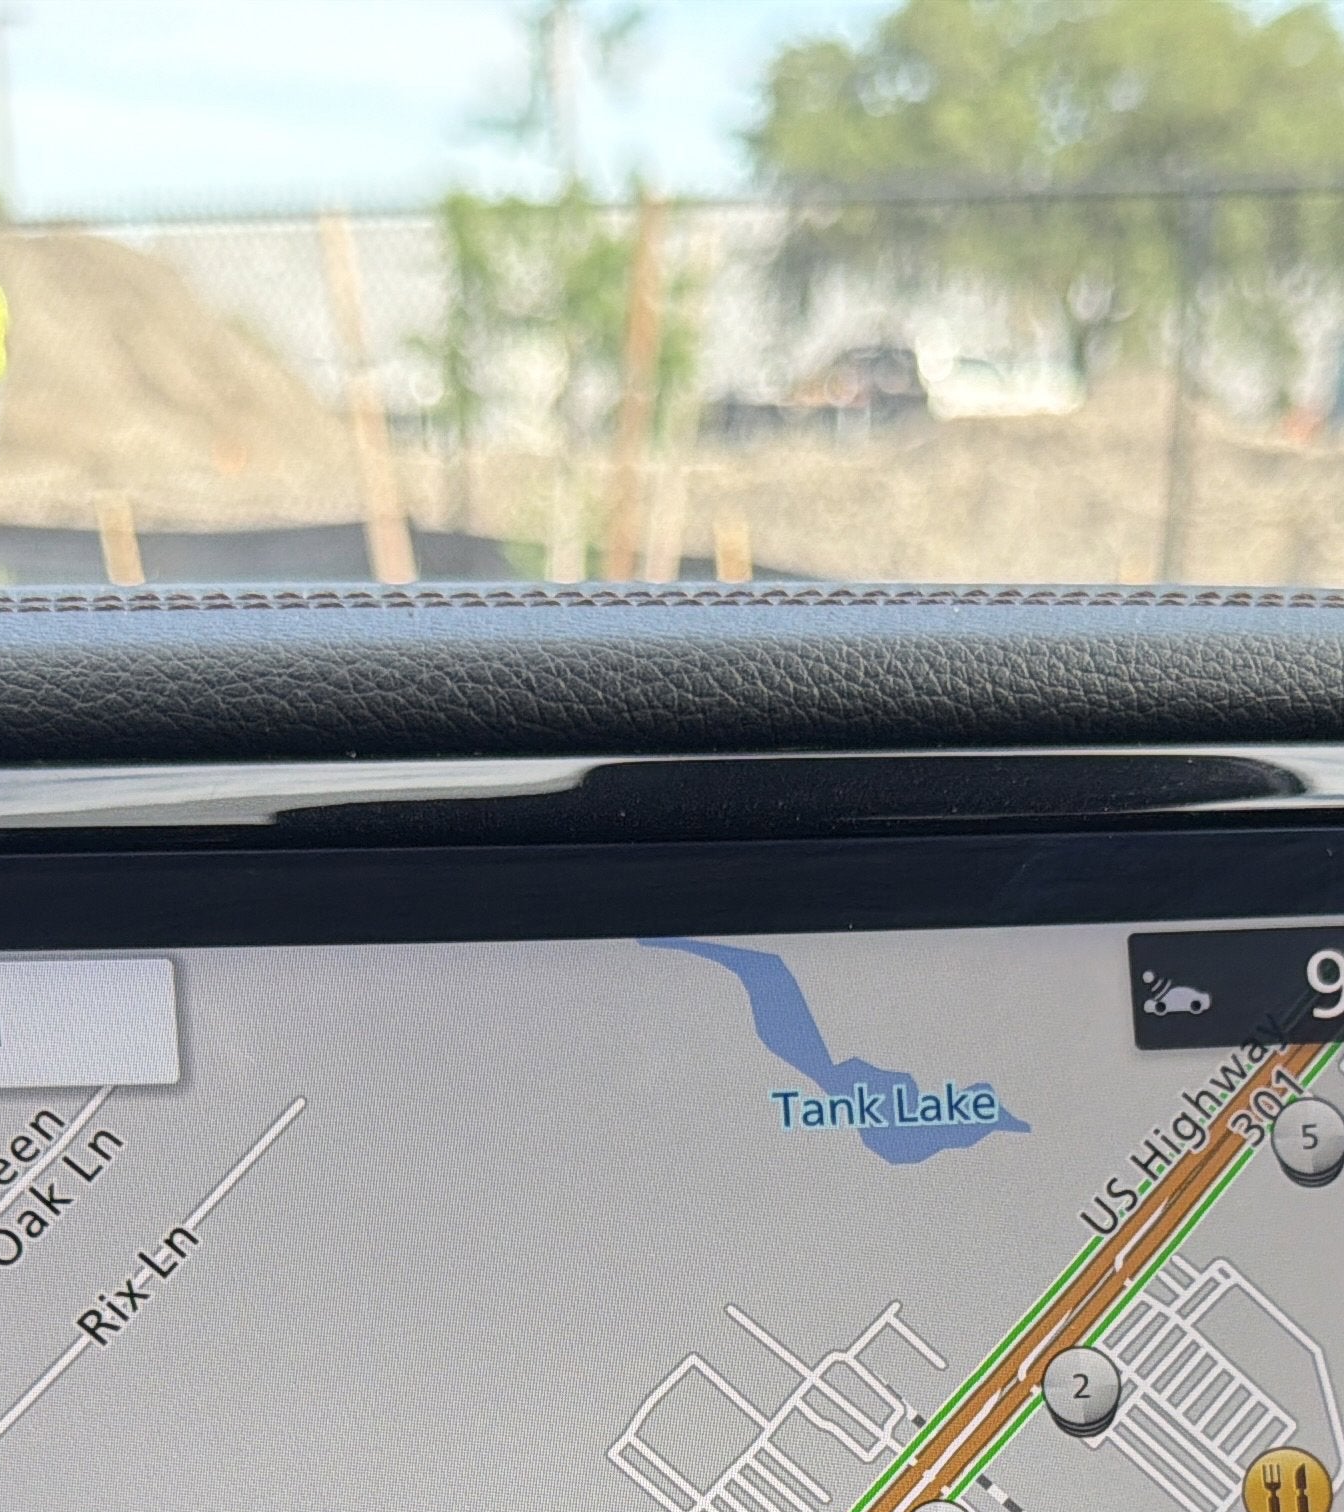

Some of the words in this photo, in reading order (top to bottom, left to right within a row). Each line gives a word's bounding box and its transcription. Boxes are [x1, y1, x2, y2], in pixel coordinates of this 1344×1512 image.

[771, 1087, 884, 1129] Tank
[895, 1082, 998, 1125] Lake
[1079, 1190, 1138, 1239] US
[1132, 1010, 1292, 1170] Highway
[1228, 1068, 1305, 1148] 301
[62, 1122, 125, 1183] Ln
[1300, 1123, 1320, 1151] 5
[76, 1275, 151, 1347] Rix
[137, 1222, 200, 1281] Ln
[1072, 1373, 1090, 1401] 2
